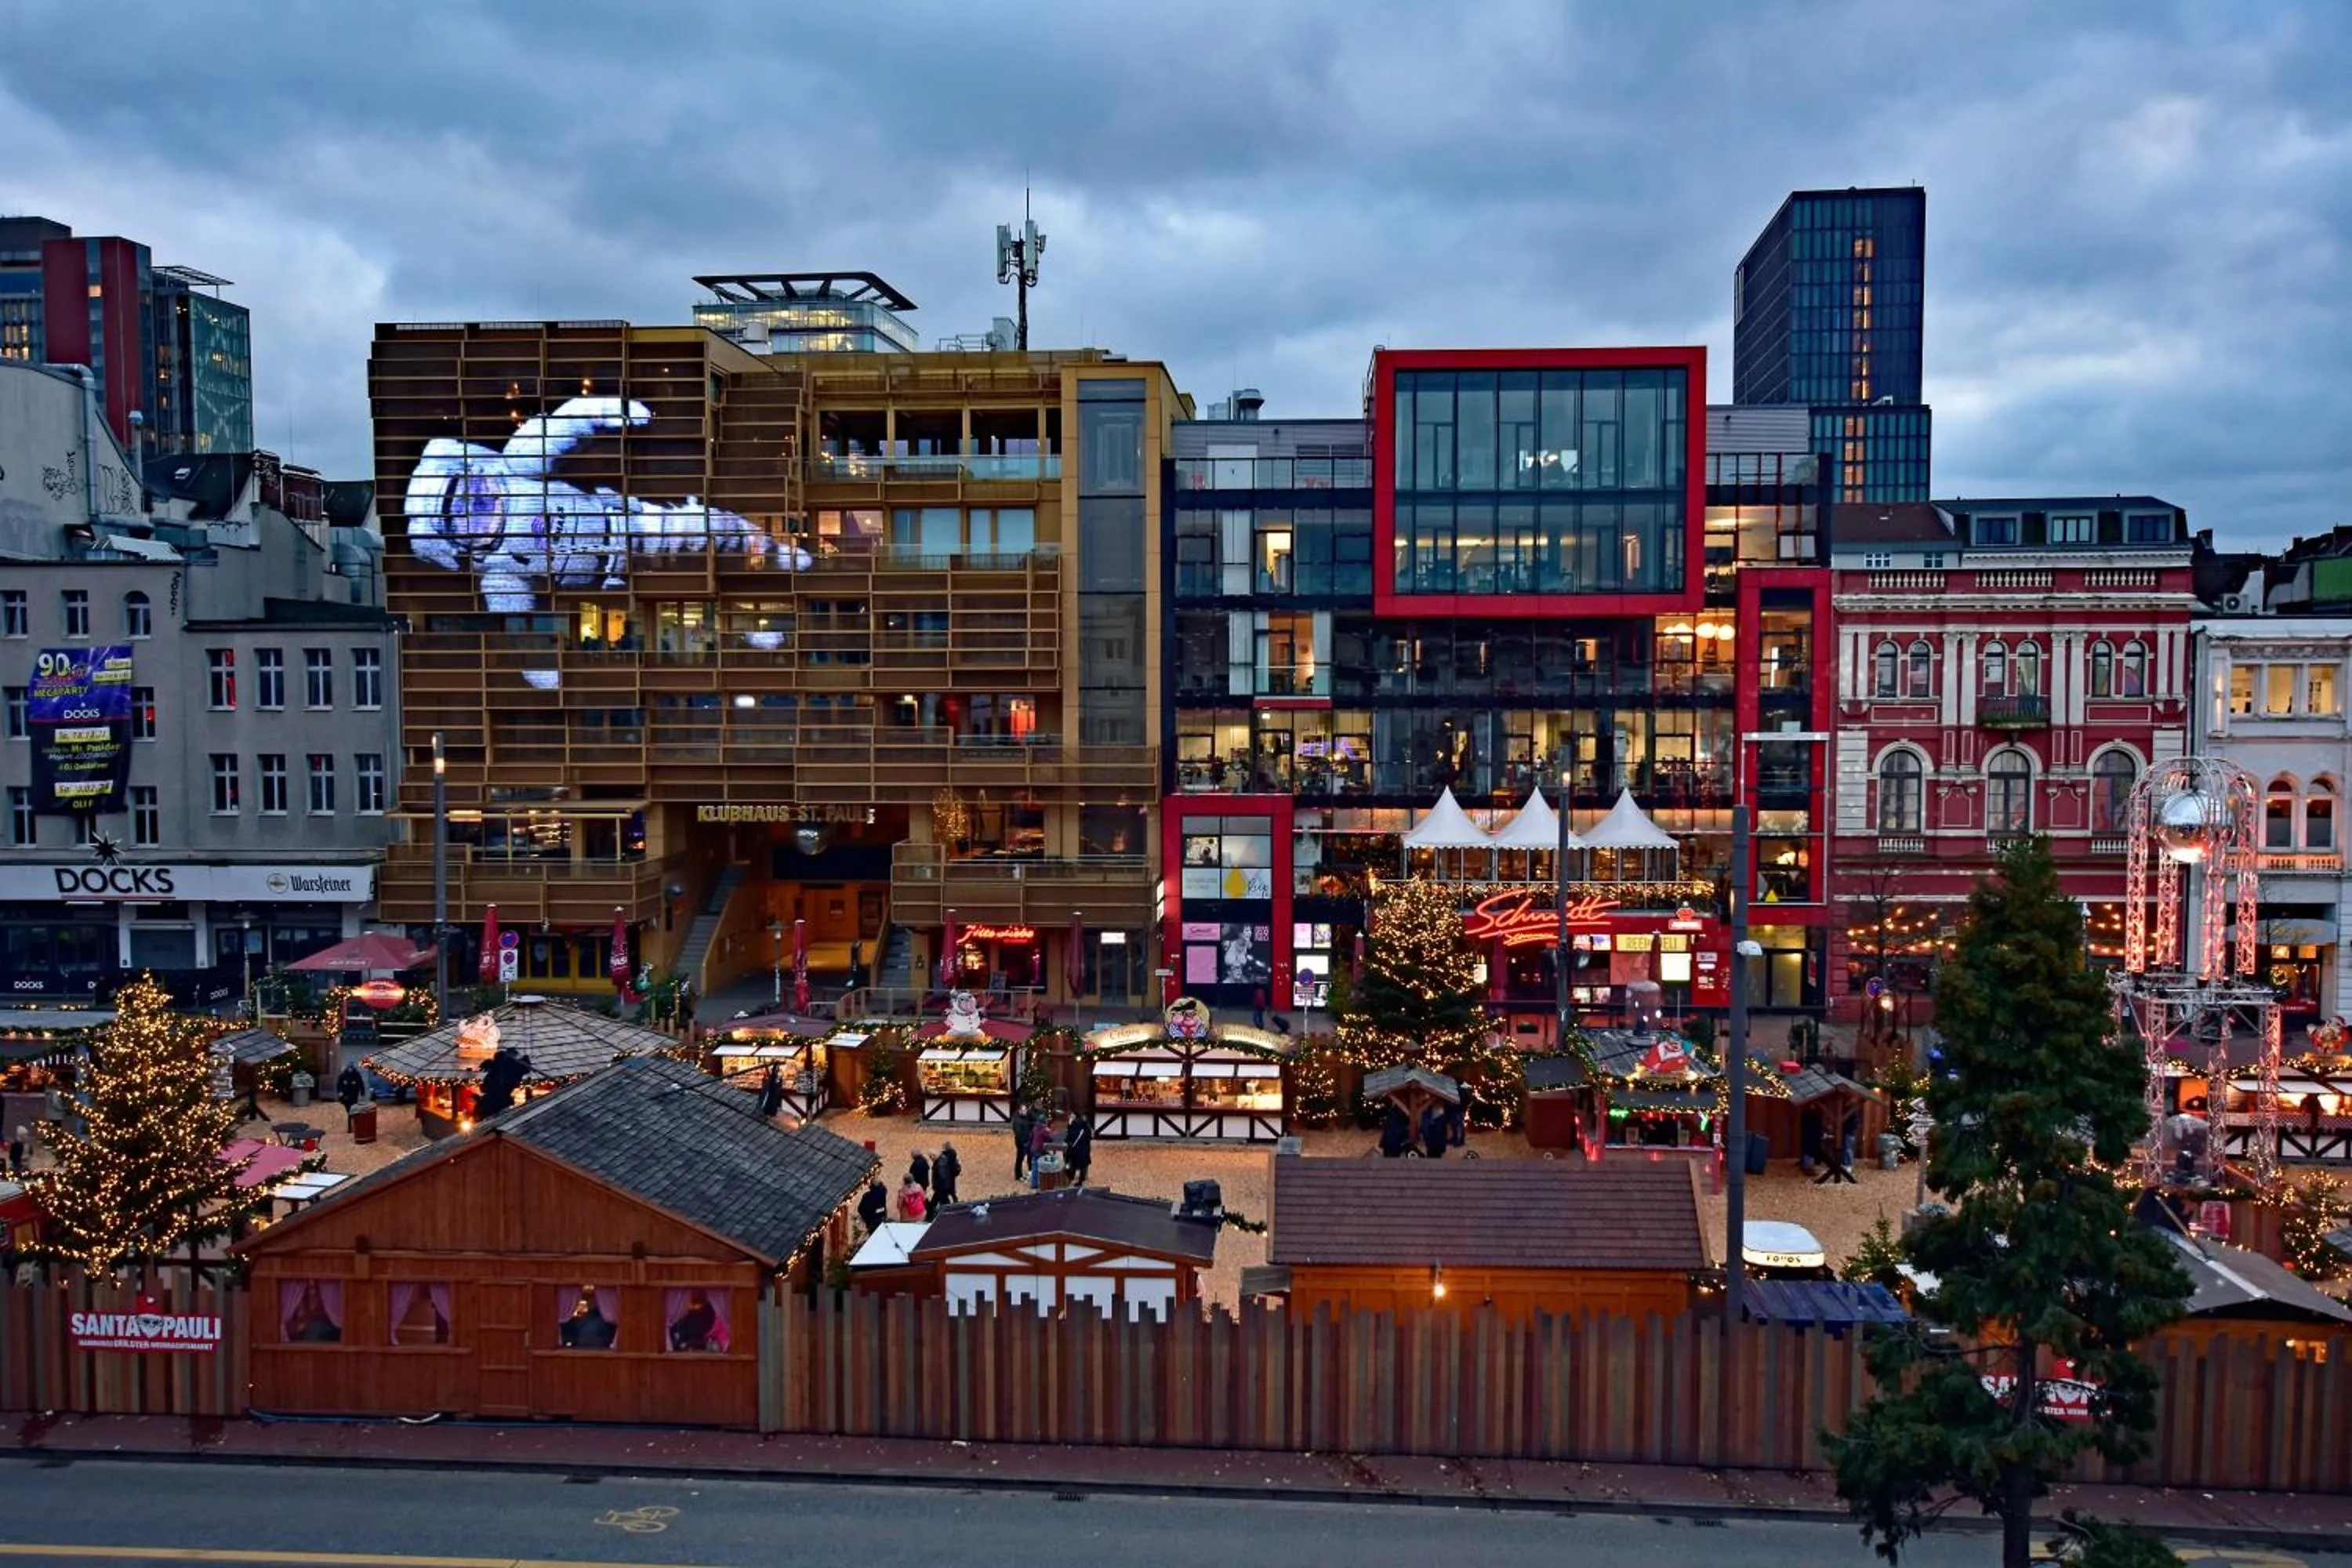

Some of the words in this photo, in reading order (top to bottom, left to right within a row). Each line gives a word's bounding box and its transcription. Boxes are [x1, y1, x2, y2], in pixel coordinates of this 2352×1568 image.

[697, 805, 789, 822] KLUBHAUS
[797, 805, 822, 822] ST.
[825, 808, 876, 824] PAULI
[54, 868, 174, 894] DOCKS
[290, 874, 351, 894] Warsteiner
[1465, 888, 1621, 935] Schmidt
[14, 981, 44, 989] DOCKS
[71, 1312, 140, 1336] SANTA
[162, 1316, 222, 1339] PAULI
